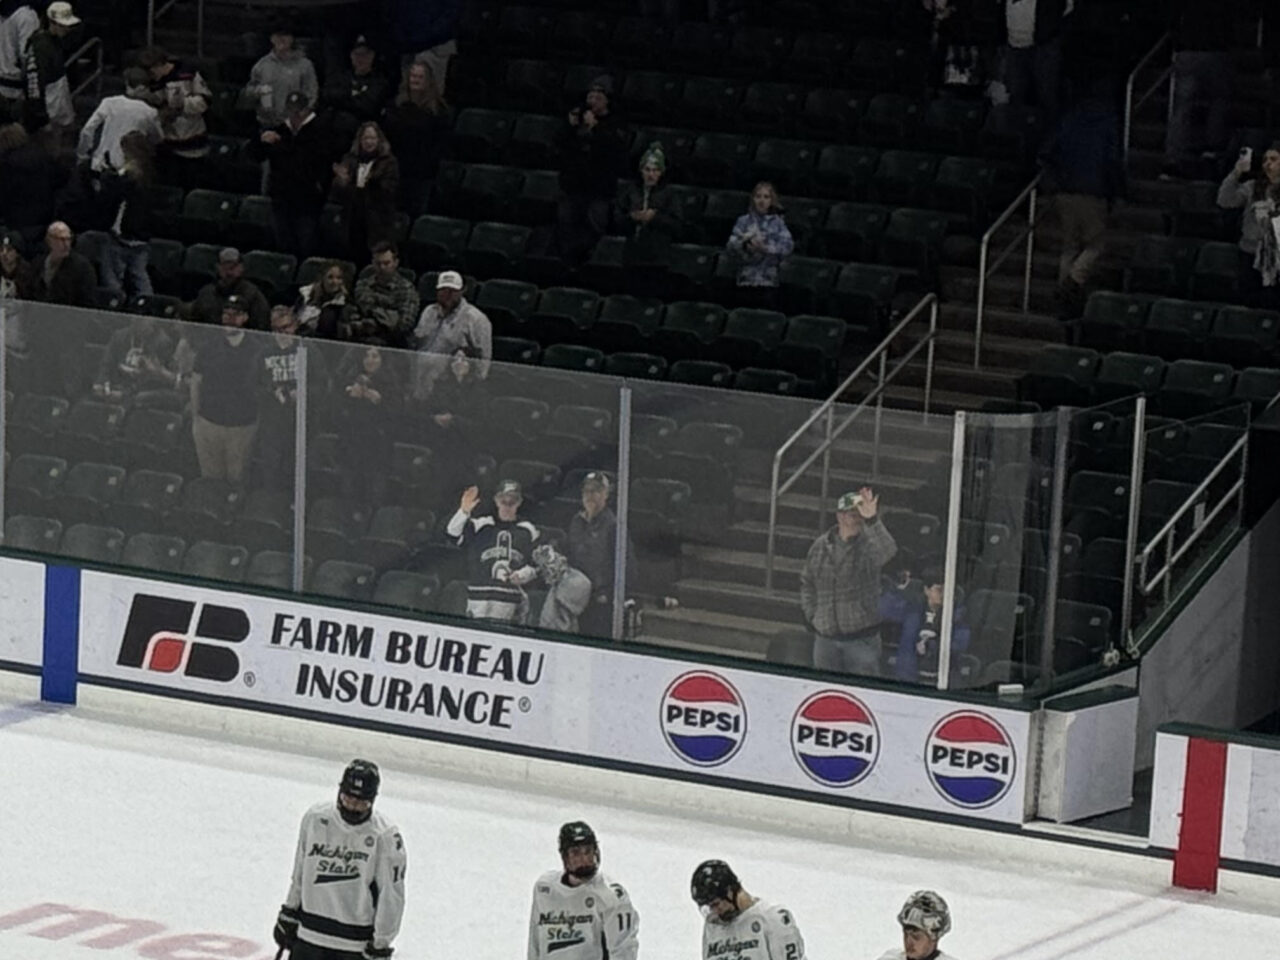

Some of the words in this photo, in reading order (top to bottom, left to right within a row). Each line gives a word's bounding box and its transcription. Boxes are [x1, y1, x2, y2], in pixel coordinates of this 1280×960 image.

[271, 613, 373, 658] FARM
[385, 631, 545, 685] BUREAU
[296, 664, 513, 728] INSURANCE
[666, 704, 741, 734] PEPSI
[797, 723, 873, 755] PEPSI
[931, 744, 1010, 775] PEPSI
[308, 843, 370, 863] Michigan
[317, 860, 360, 874] State
[538, 909, 594, 930] Michigan
[617, 912, 631, 932] 11
